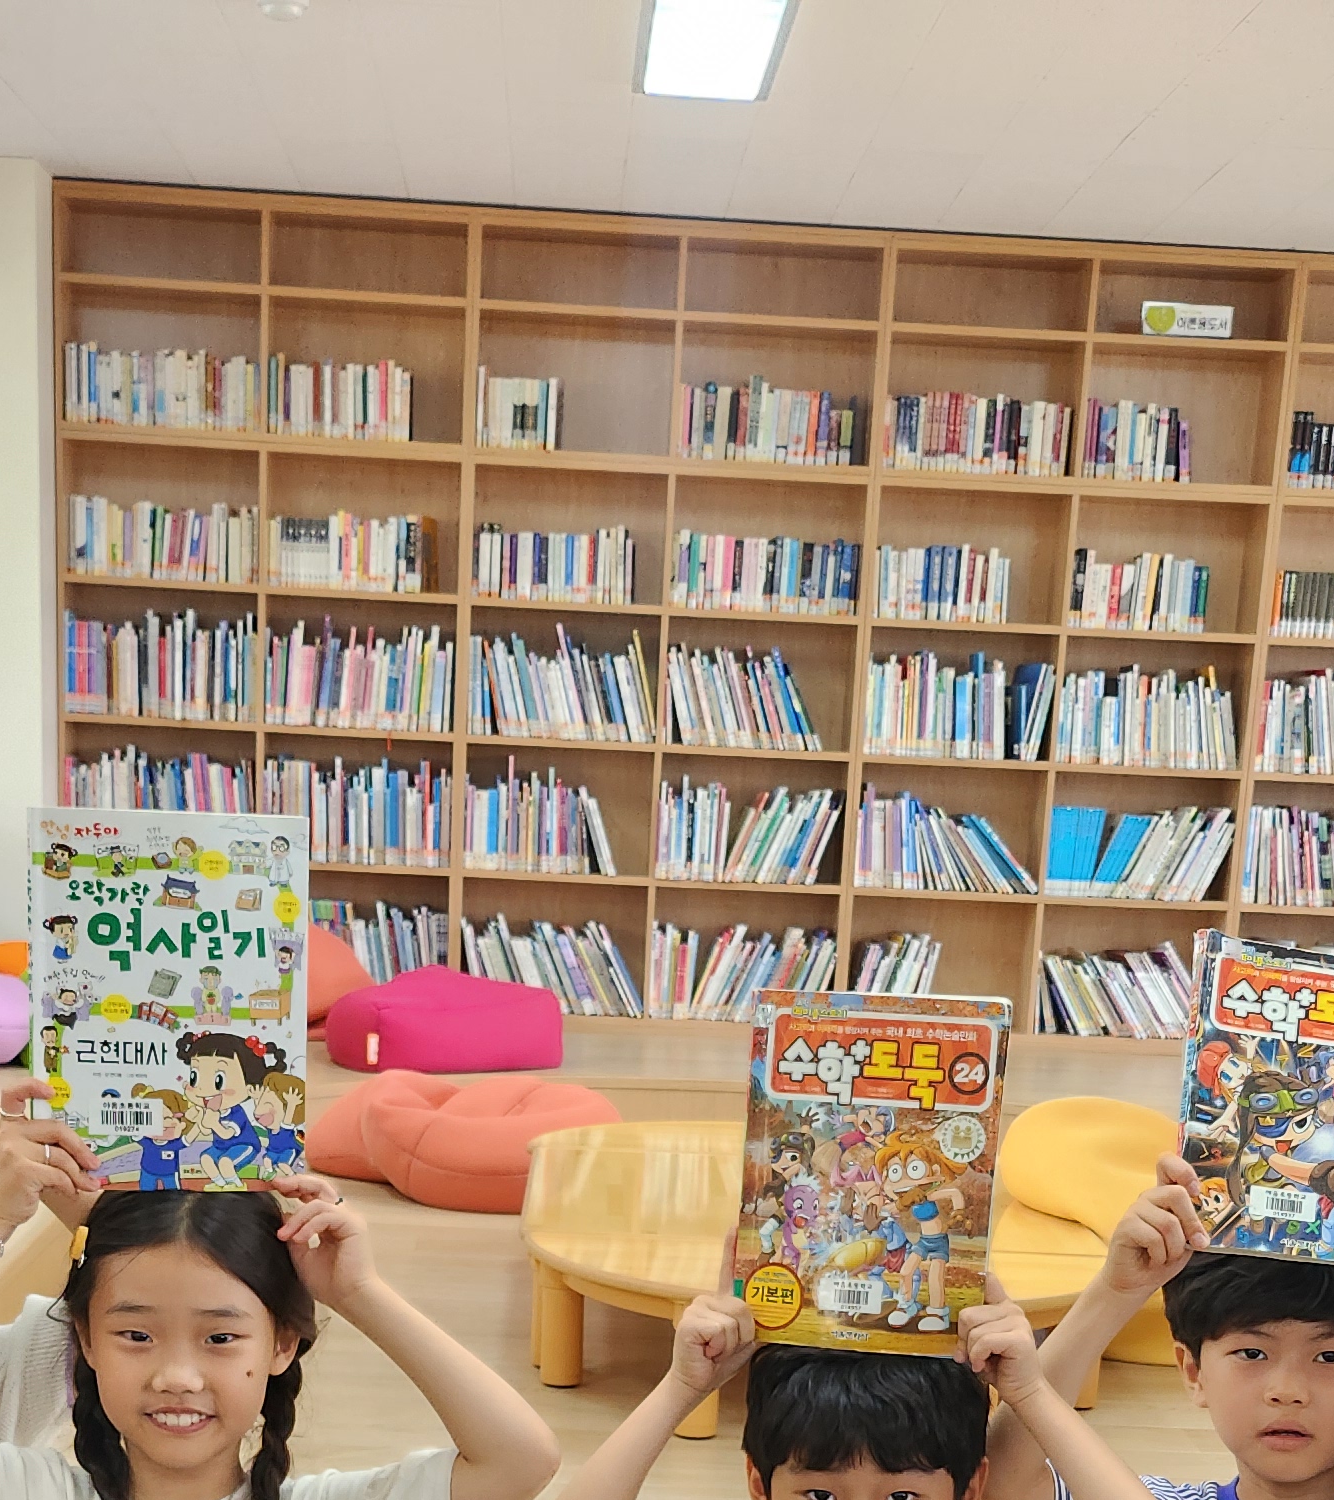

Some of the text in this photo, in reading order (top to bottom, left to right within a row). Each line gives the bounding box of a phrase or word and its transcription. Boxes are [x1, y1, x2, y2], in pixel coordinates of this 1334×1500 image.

[74, 822, 119, 839] 자두야
[66, 879, 151, 907] 오락가락
[86, 907, 267, 971] 역사일기
[75, 1039, 167, 1066] 근현대사
[953, 1062, 985, 1084] 24
[751, 1286, 794, 1305] 기본편
